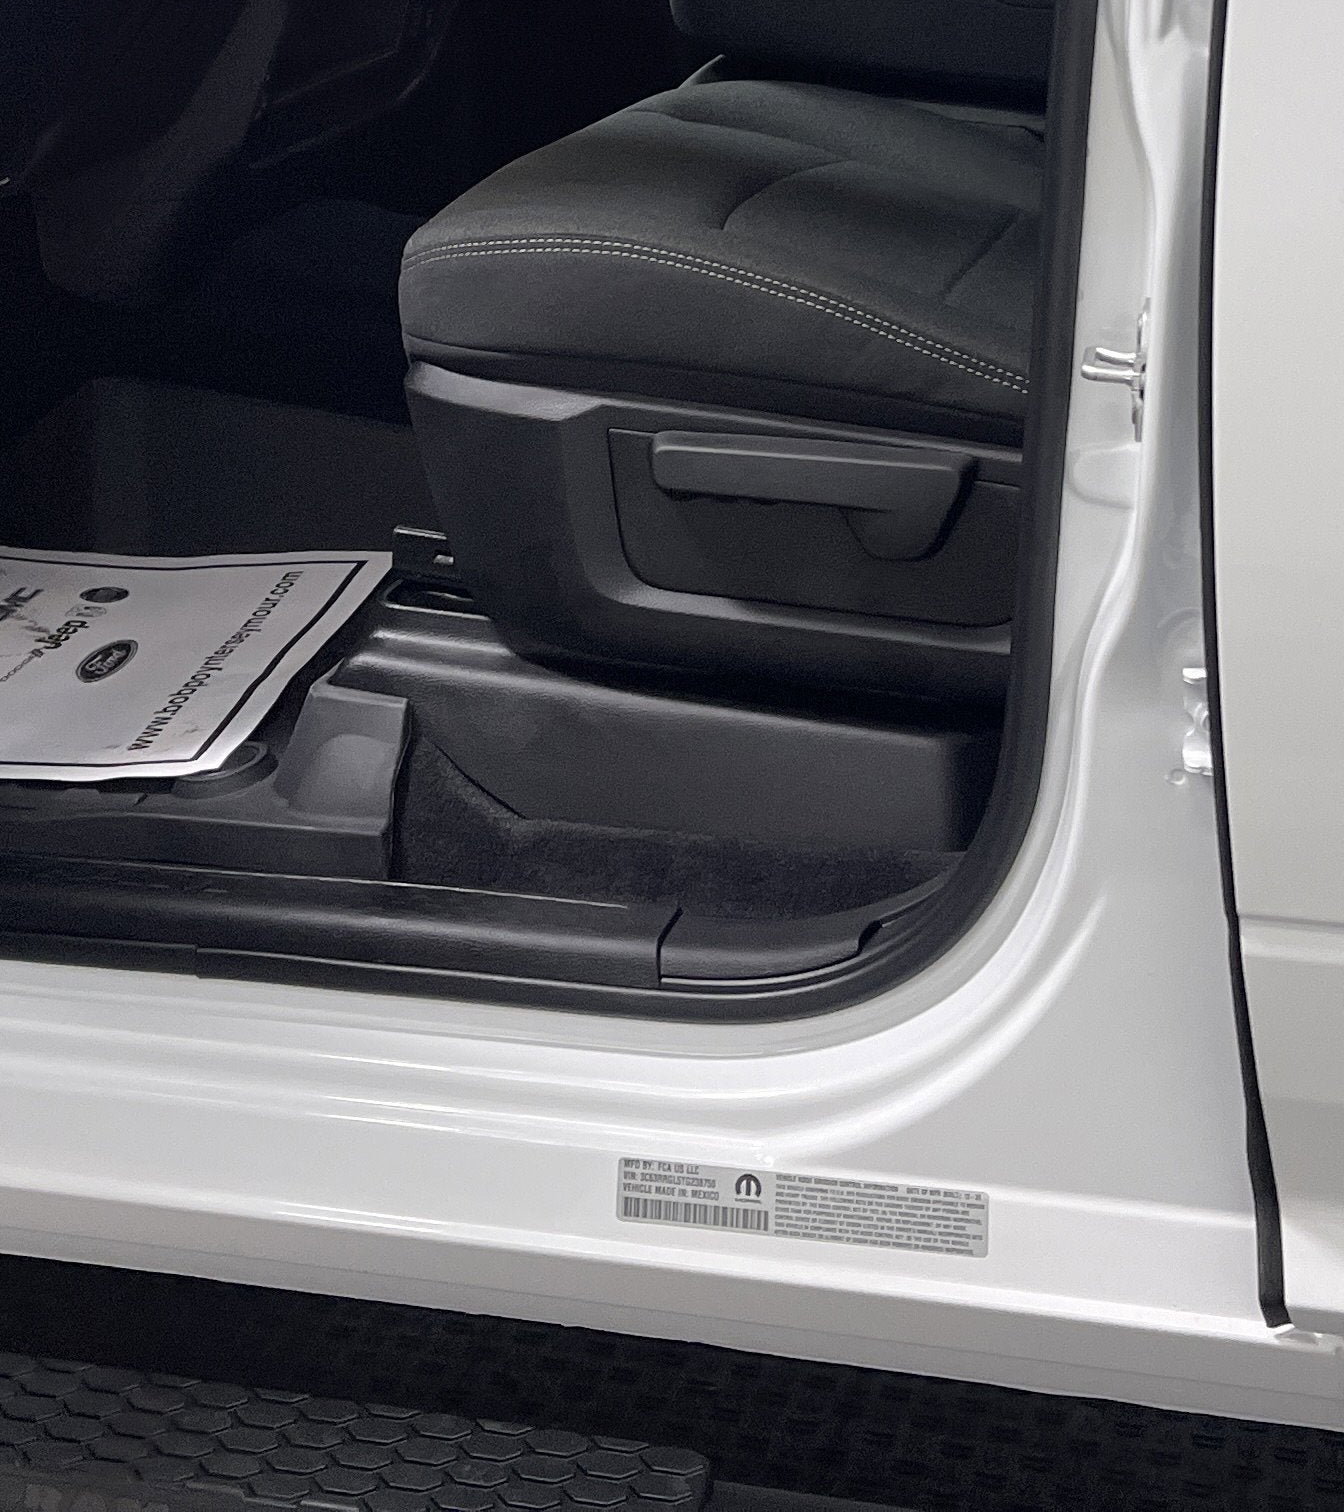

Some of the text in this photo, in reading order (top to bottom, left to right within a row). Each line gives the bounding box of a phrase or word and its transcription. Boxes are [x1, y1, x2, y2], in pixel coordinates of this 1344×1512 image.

[34, 619, 90, 650] Jeep
[127, 570, 304, 751] www.bobpoynterseymour.com
[623, 1171, 637, 1181] VIN:
[657, 1162, 672, 1173] FCA
[674, 1164, 684, 1174] US
[686, 1165, 700, 1175] LLC
[623, 1182, 720, 1202] VEHICLE MADE IN: MEXICO
